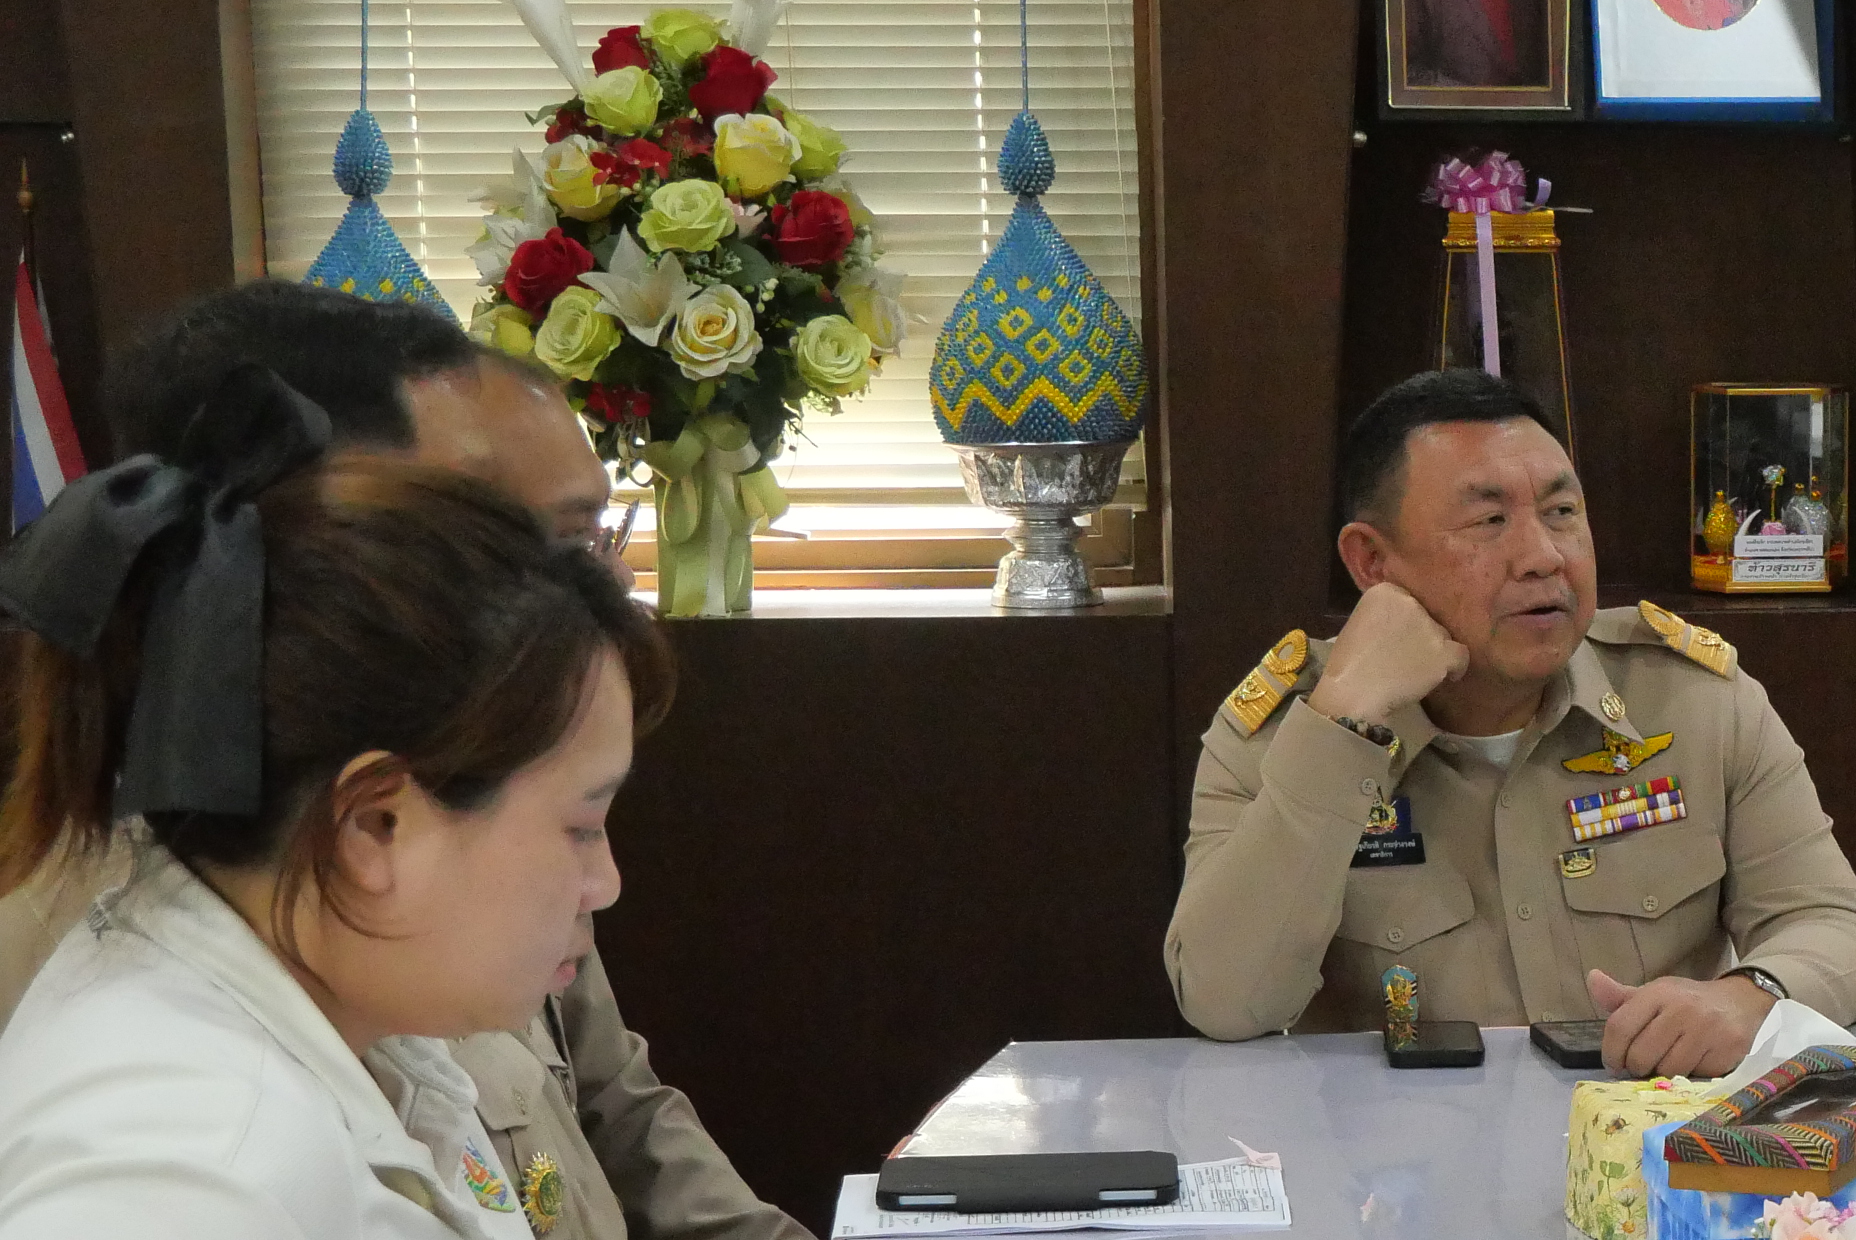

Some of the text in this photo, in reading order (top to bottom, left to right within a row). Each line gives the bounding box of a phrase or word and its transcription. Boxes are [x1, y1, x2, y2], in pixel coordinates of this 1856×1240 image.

[1747, 561, 1816, 575] ท้าวสุรนารี
